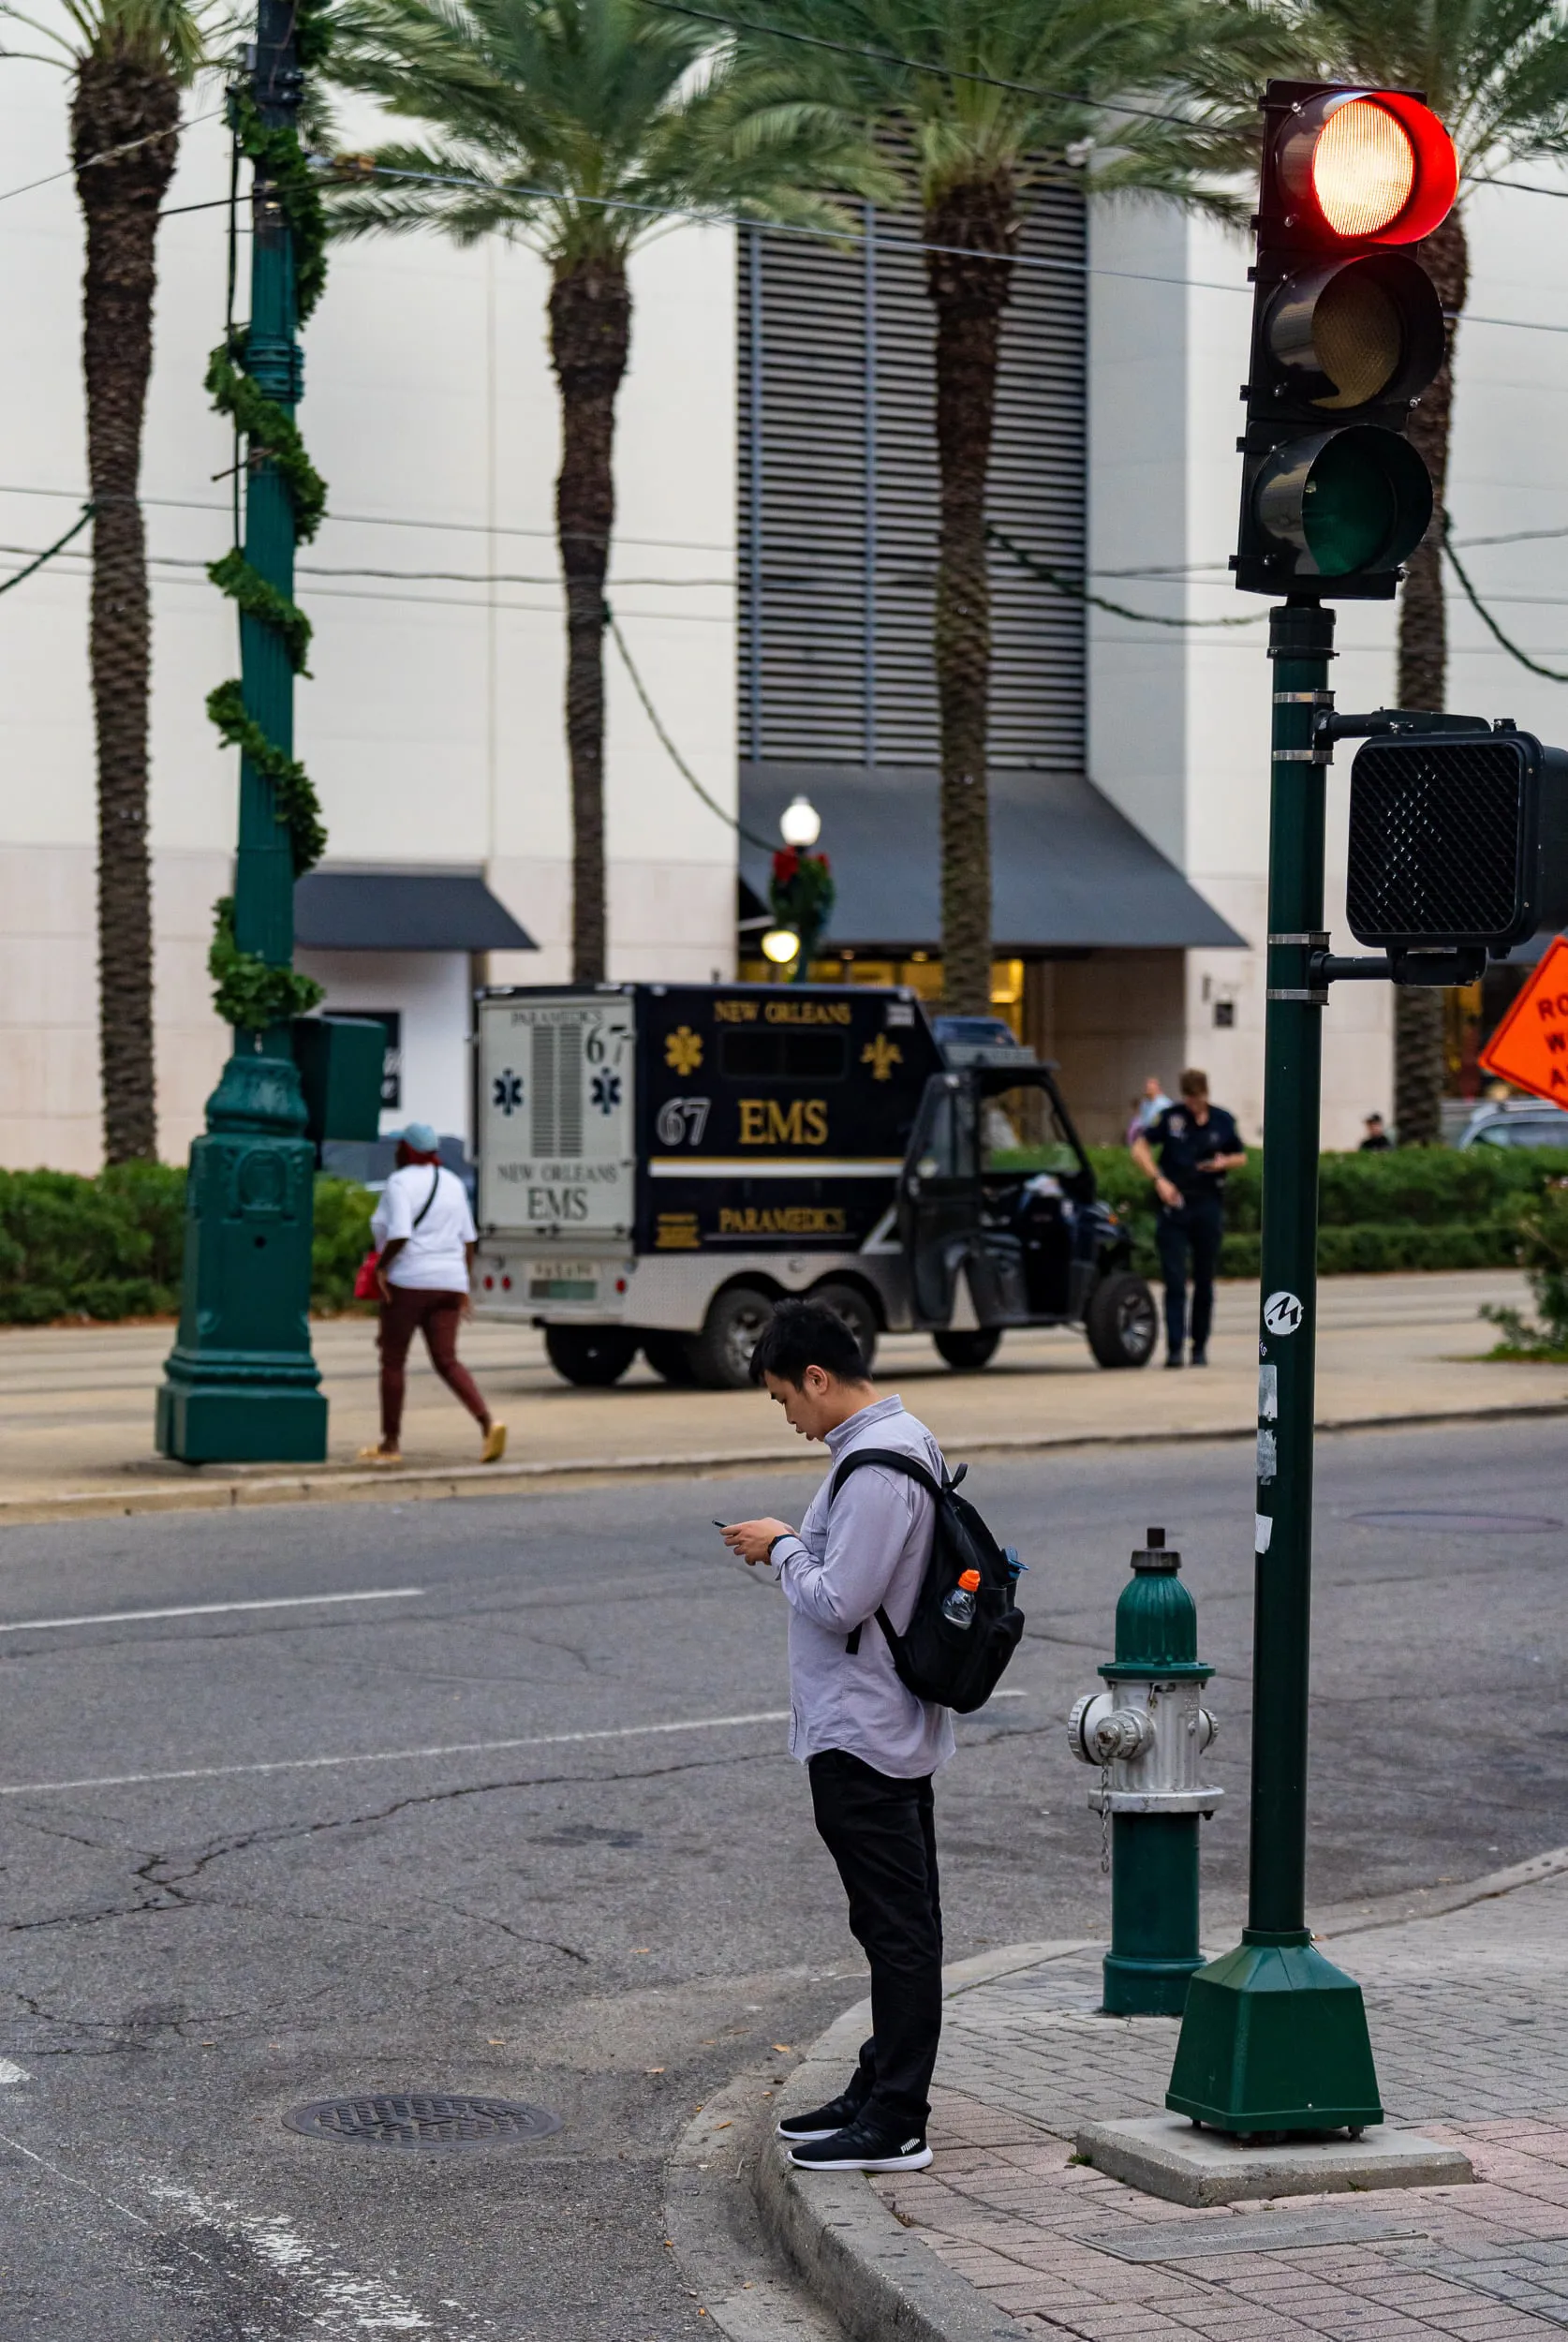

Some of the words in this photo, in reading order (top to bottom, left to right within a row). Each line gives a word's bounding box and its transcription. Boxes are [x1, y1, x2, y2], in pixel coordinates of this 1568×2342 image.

[714, 1000, 760, 1022] NEW
[764, 1001, 852, 1025] ORLEANS
[586, 1021, 628, 1066] 67
[657, 1096, 711, 1146] 67
[737, 1098, 829, 1146] EMS
[497, 1163, 533, 1182] NEW
[540, 1163, 618, 1184] ORLEANS
[527, 1186, 589, 1221] EMS
[717, 1207, 847, 1233] PARAMEDICS
